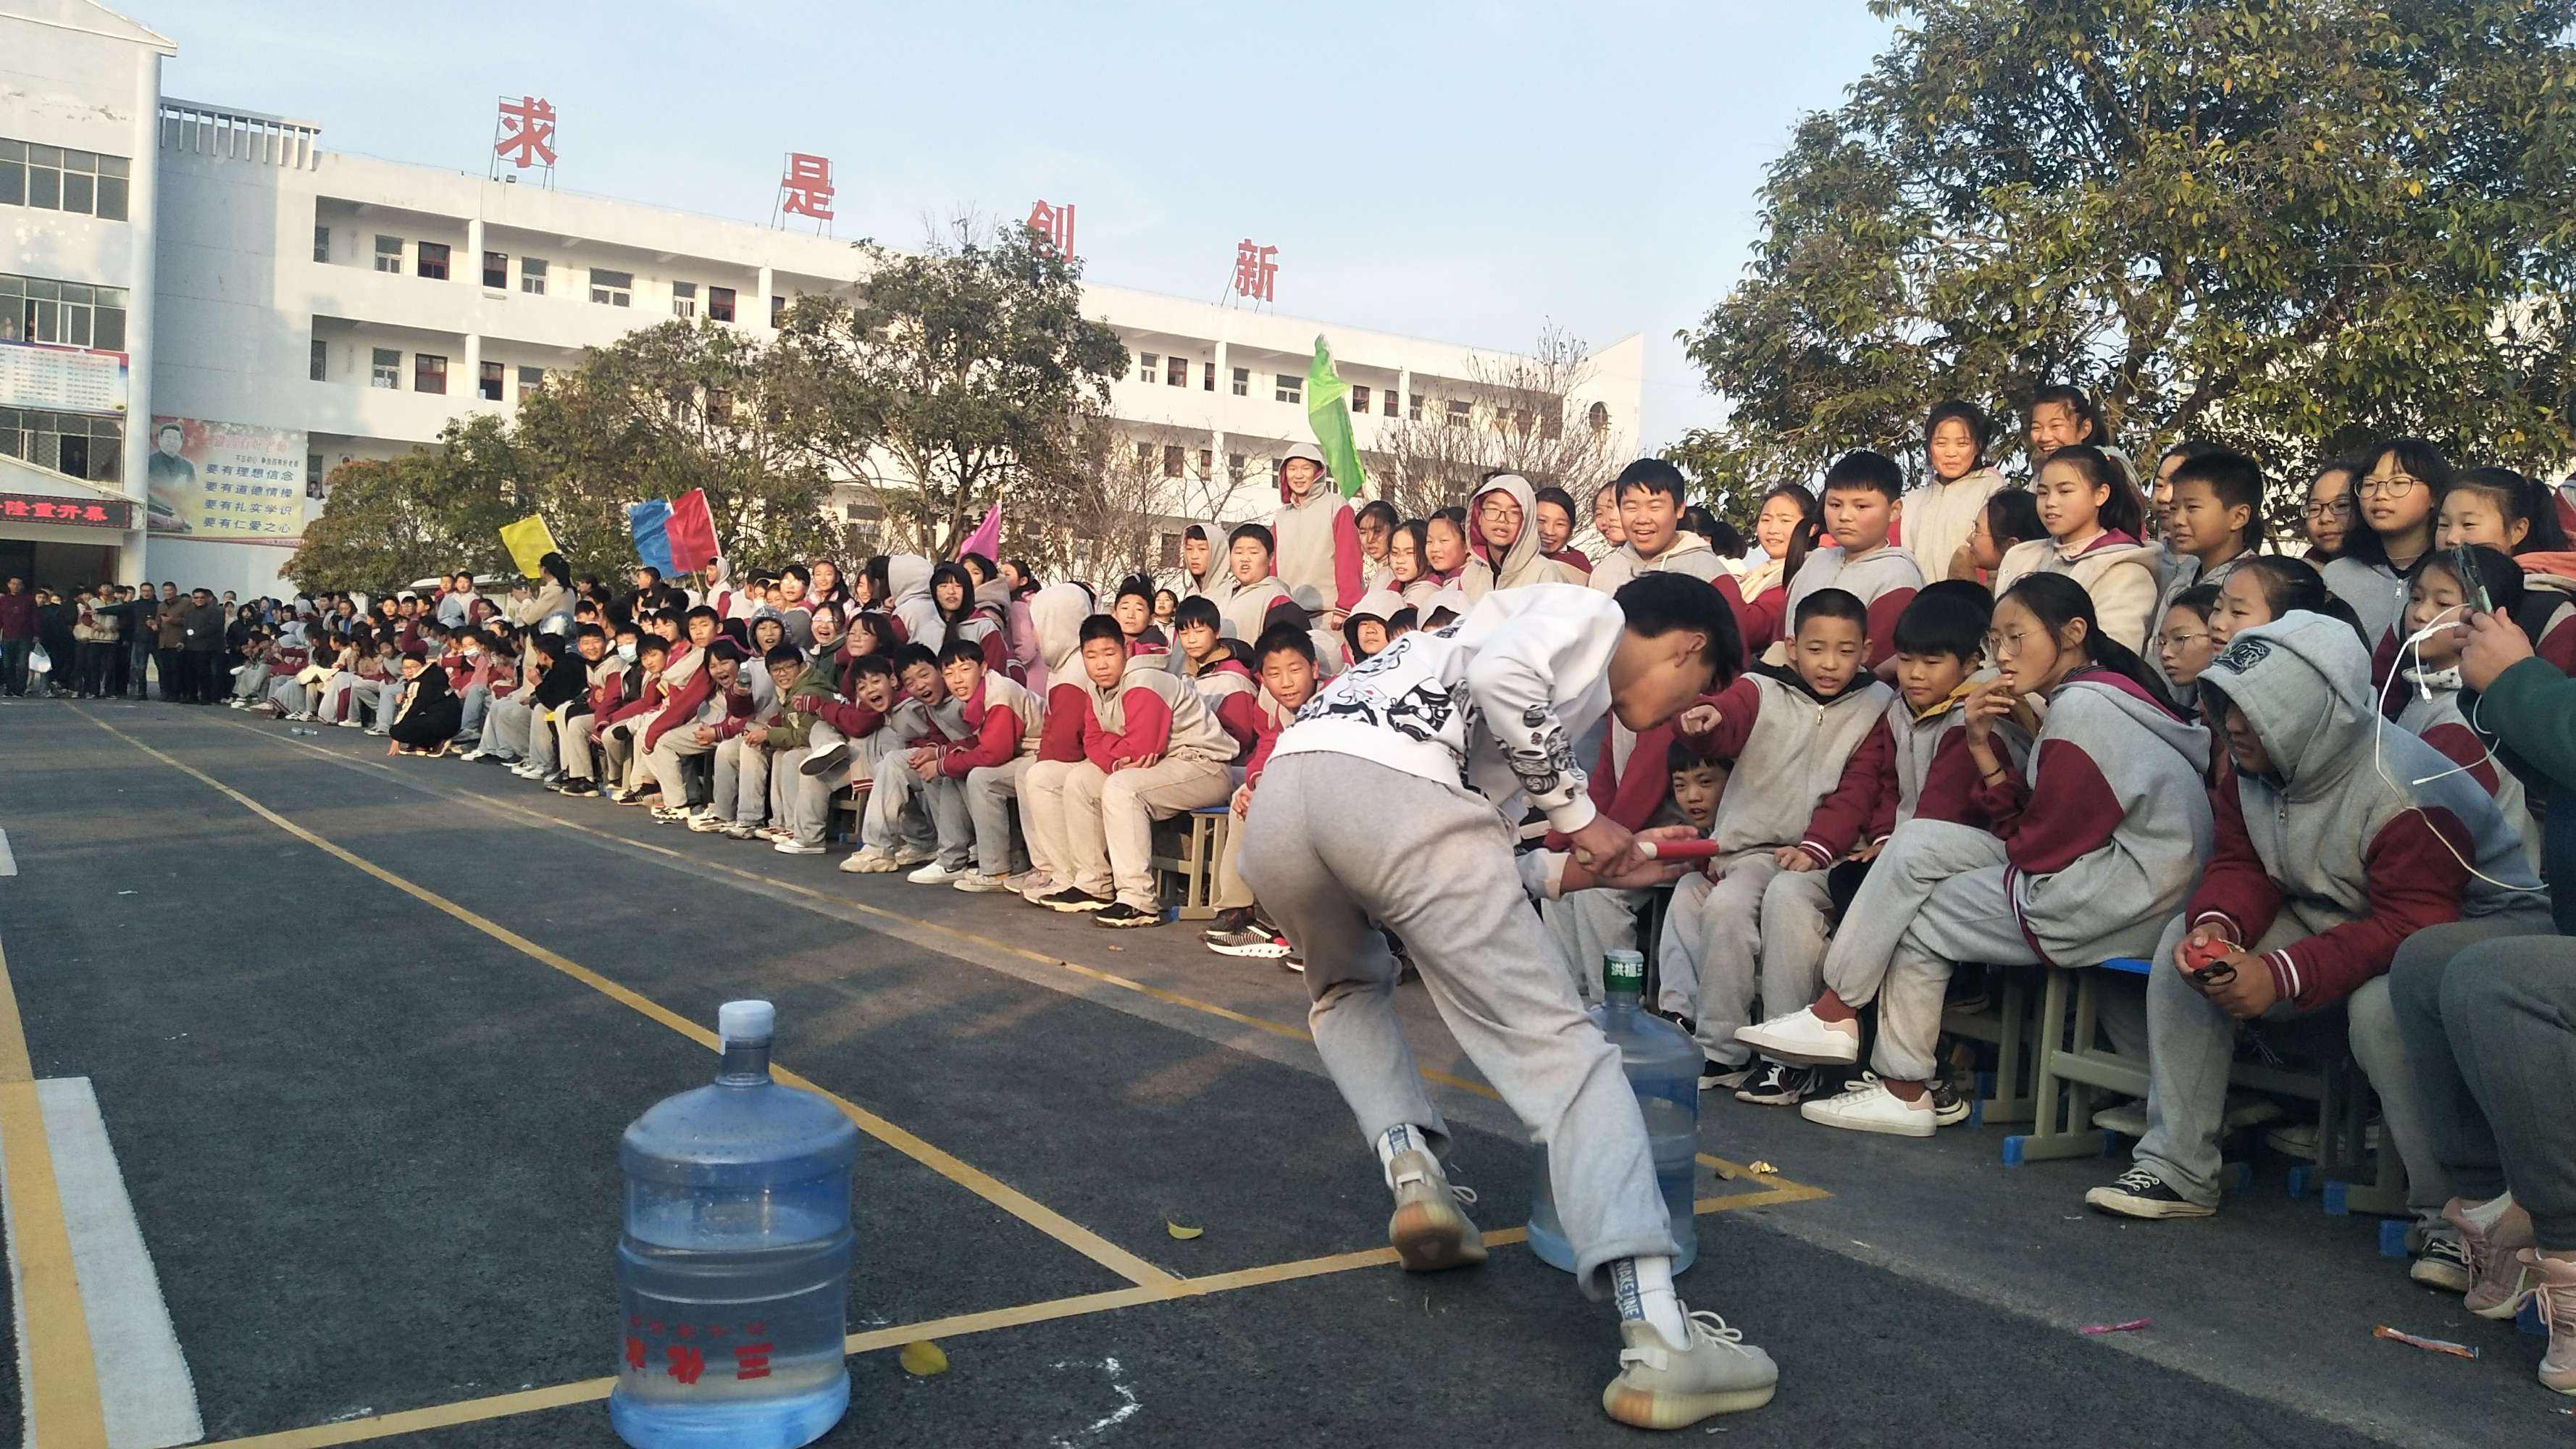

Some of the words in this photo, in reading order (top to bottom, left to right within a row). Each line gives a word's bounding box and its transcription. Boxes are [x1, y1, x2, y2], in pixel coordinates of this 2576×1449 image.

[495, 95, 558, 167] 求
[782, 152, 835, 220] 是
[1026, 199, 1075, 264] 创
[1234, 238, 1279, 302] 新
[205, 463, 294, 482] 要有理想信念
[204, 481, 293, 498] 要有道德情操
[0, 500, 109, 522] 隆重开幕
[204, 499, 292, 516] 要有扎实学识
[203, 517, 290, 533] 要有仁爱之心
